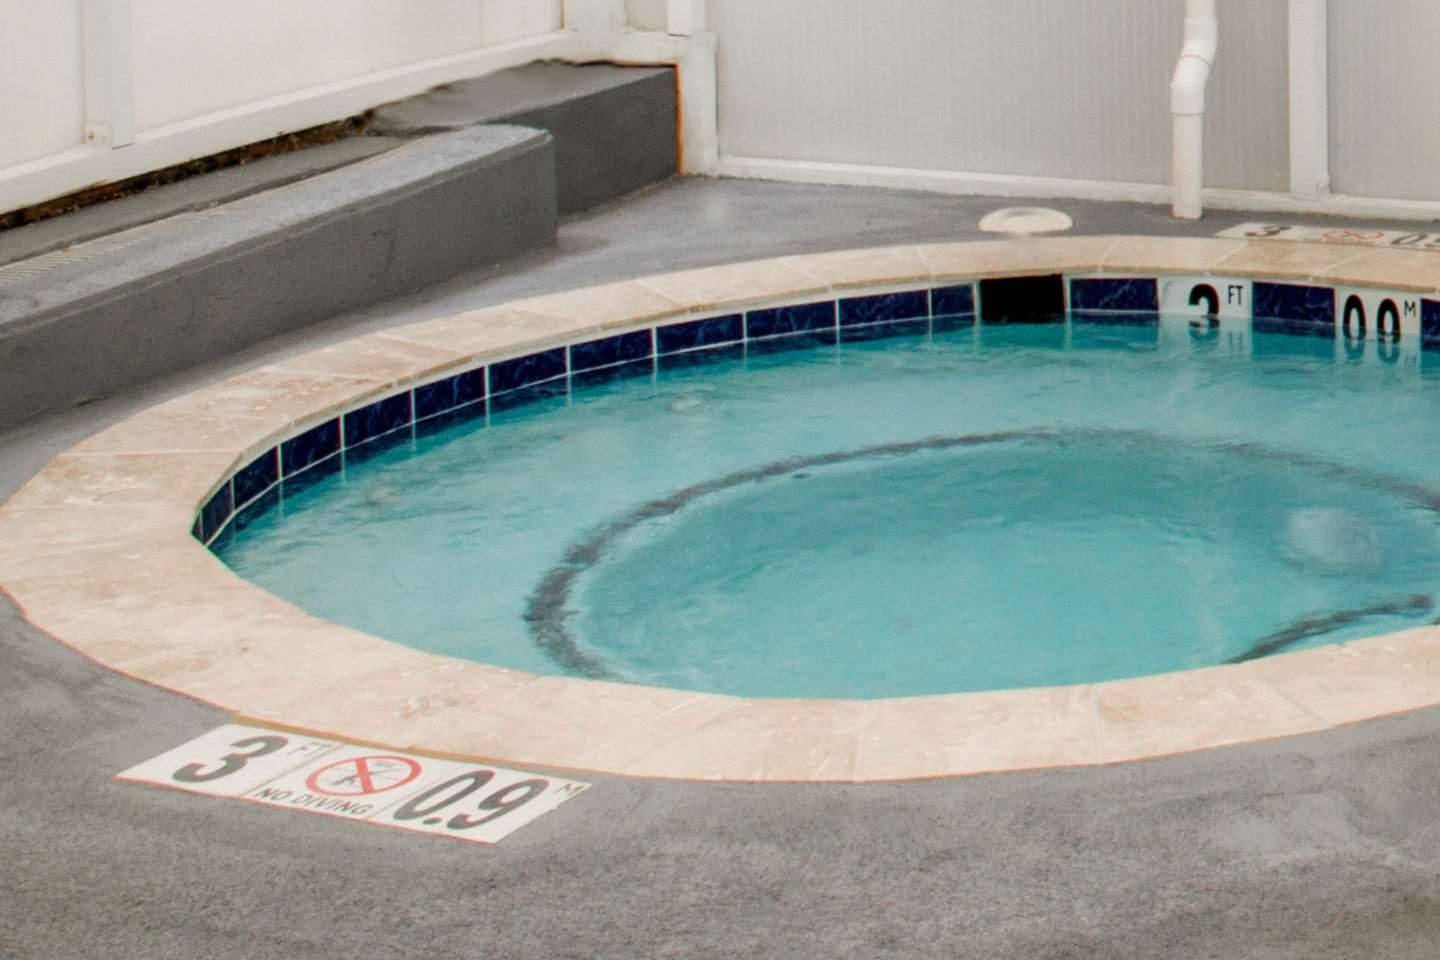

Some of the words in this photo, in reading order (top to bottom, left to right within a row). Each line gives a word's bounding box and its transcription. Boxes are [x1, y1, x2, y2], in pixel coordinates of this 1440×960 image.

[1227, 285, 1243, 305] FT
[1404, 300, 1417, 318] M
[172, 735, 289, 783] 3
[393, 769, 550, 830] 0.9
[255, 787, 294, 803] NO
[290, 792, 374, 816] DIVING
